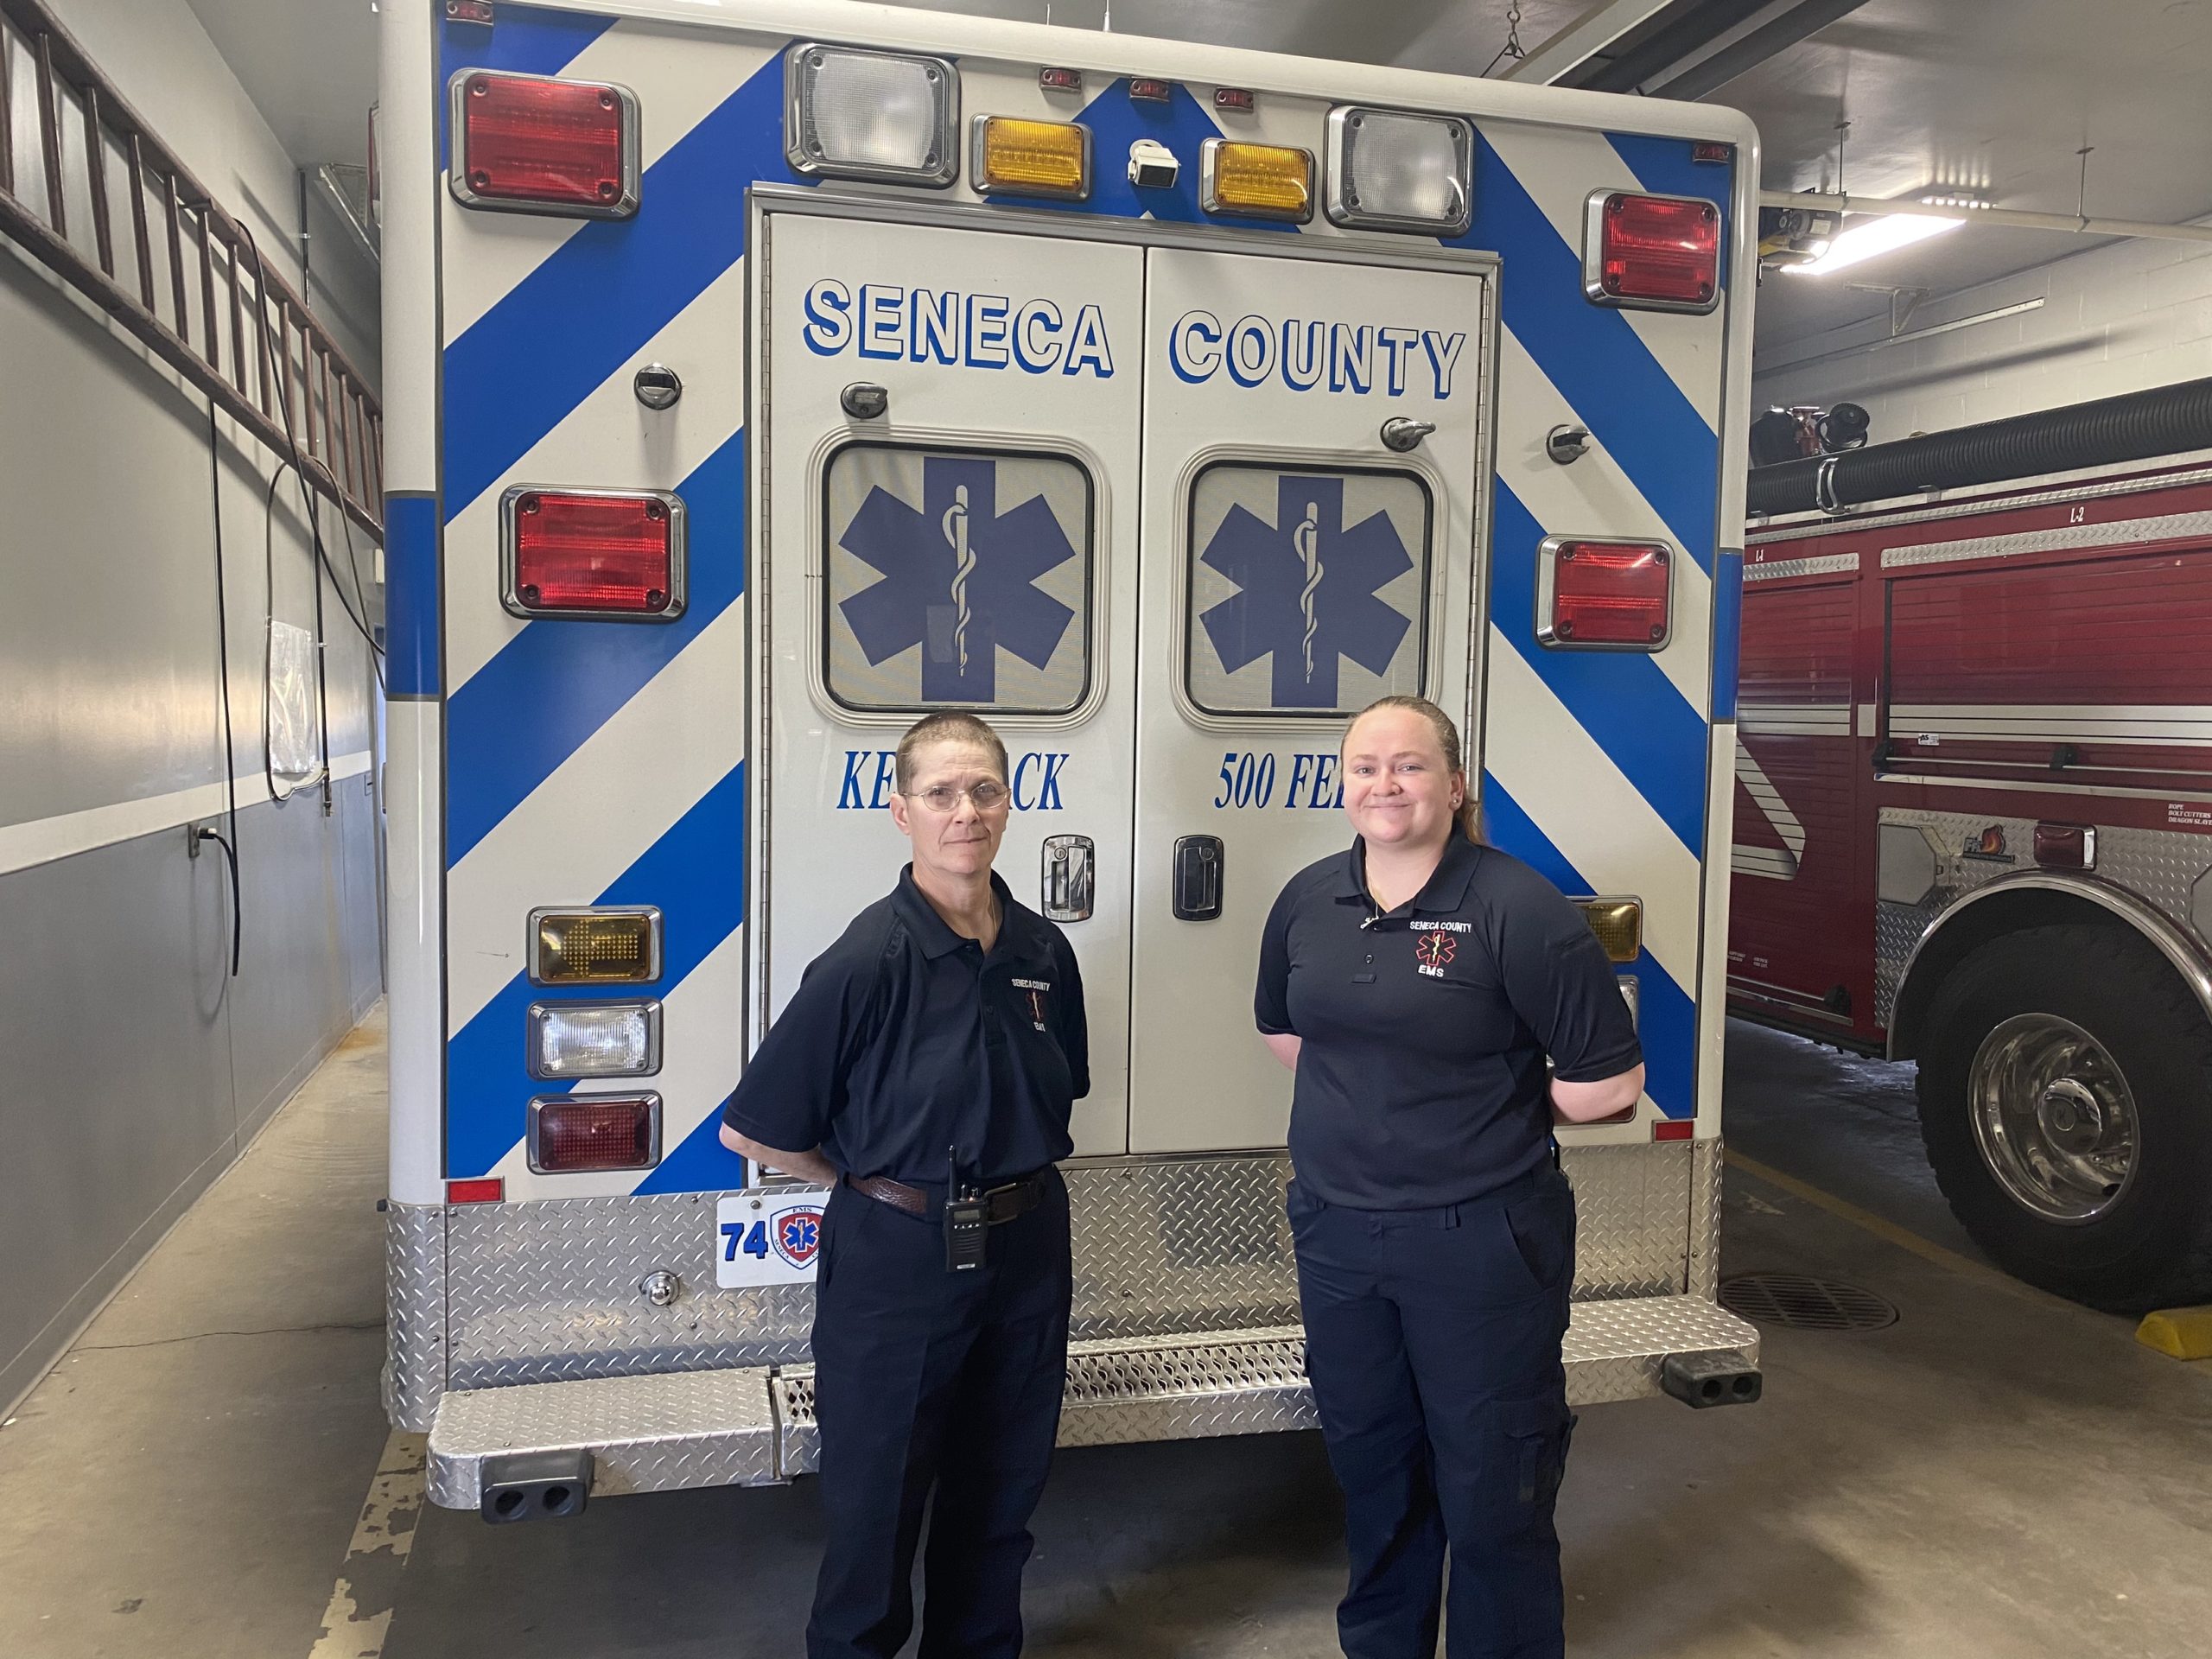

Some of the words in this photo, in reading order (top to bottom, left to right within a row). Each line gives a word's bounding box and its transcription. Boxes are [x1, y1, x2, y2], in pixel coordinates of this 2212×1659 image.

[803, 278, 1115, 378] SENECA
[1169, 309, 1466, 400] COUNTY
[836, 751, 898, 810] KE
[1005, 752, 1070, 811] CK
[1214, 752, 1276, 809] 500
[1285, 753, 1345, 810] FE
[1409, 921, 1440, 931] SENECA
[1440, 922, 1471, 933] COUNTY
[1418, 964, 1445, 977] EMS
[721, 1220, 769, 1262] 74
